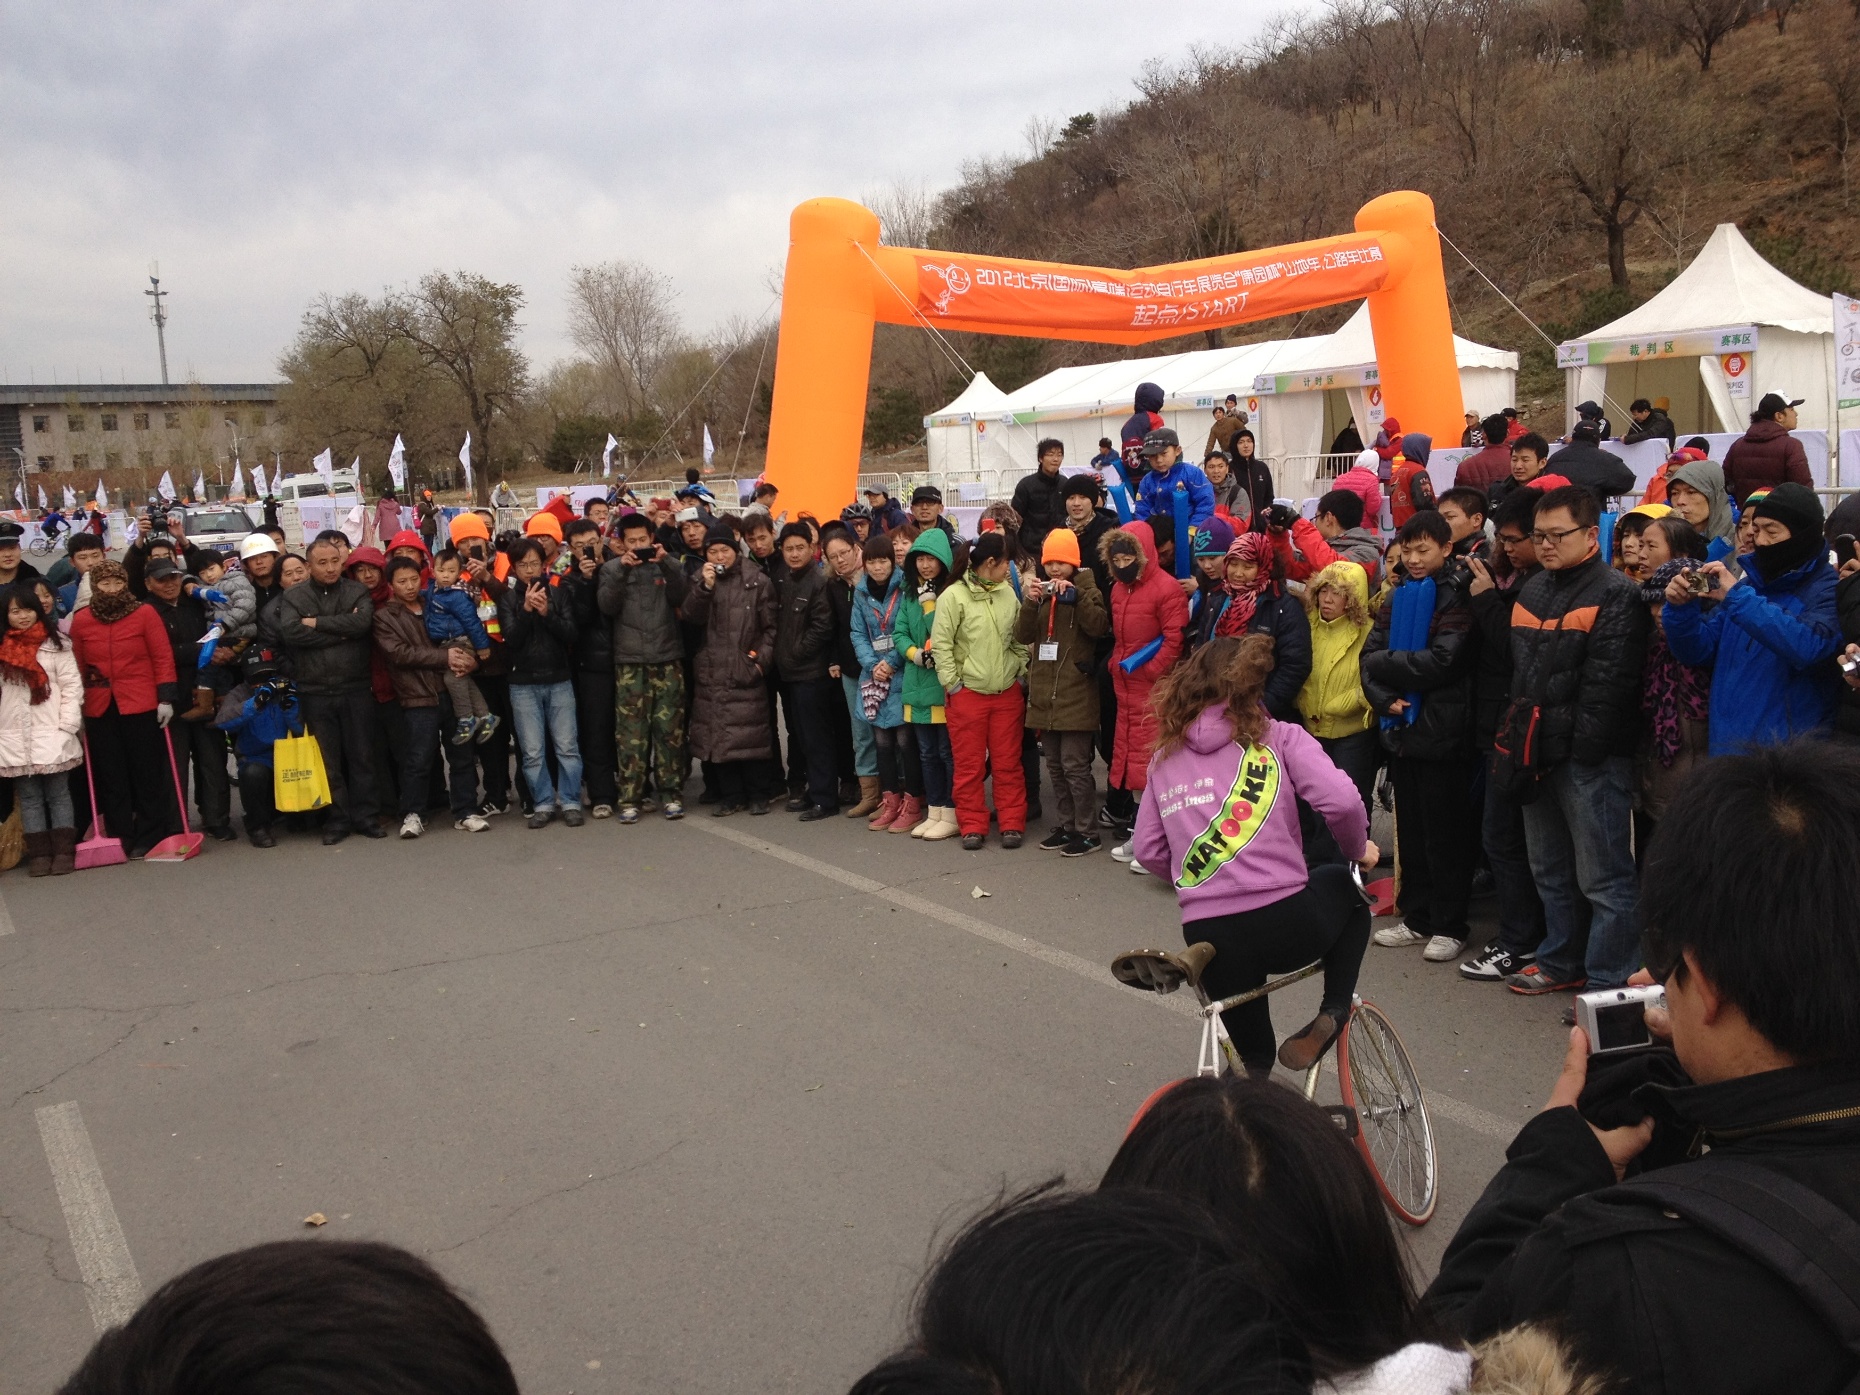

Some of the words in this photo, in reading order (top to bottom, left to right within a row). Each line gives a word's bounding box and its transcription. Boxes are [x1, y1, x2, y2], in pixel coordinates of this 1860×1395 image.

[1721, 333, 1751, 347] 赛事区
[1629, 340, 1674, 356] 裁判区
[1303, 375, 1334, 387] 计时区
